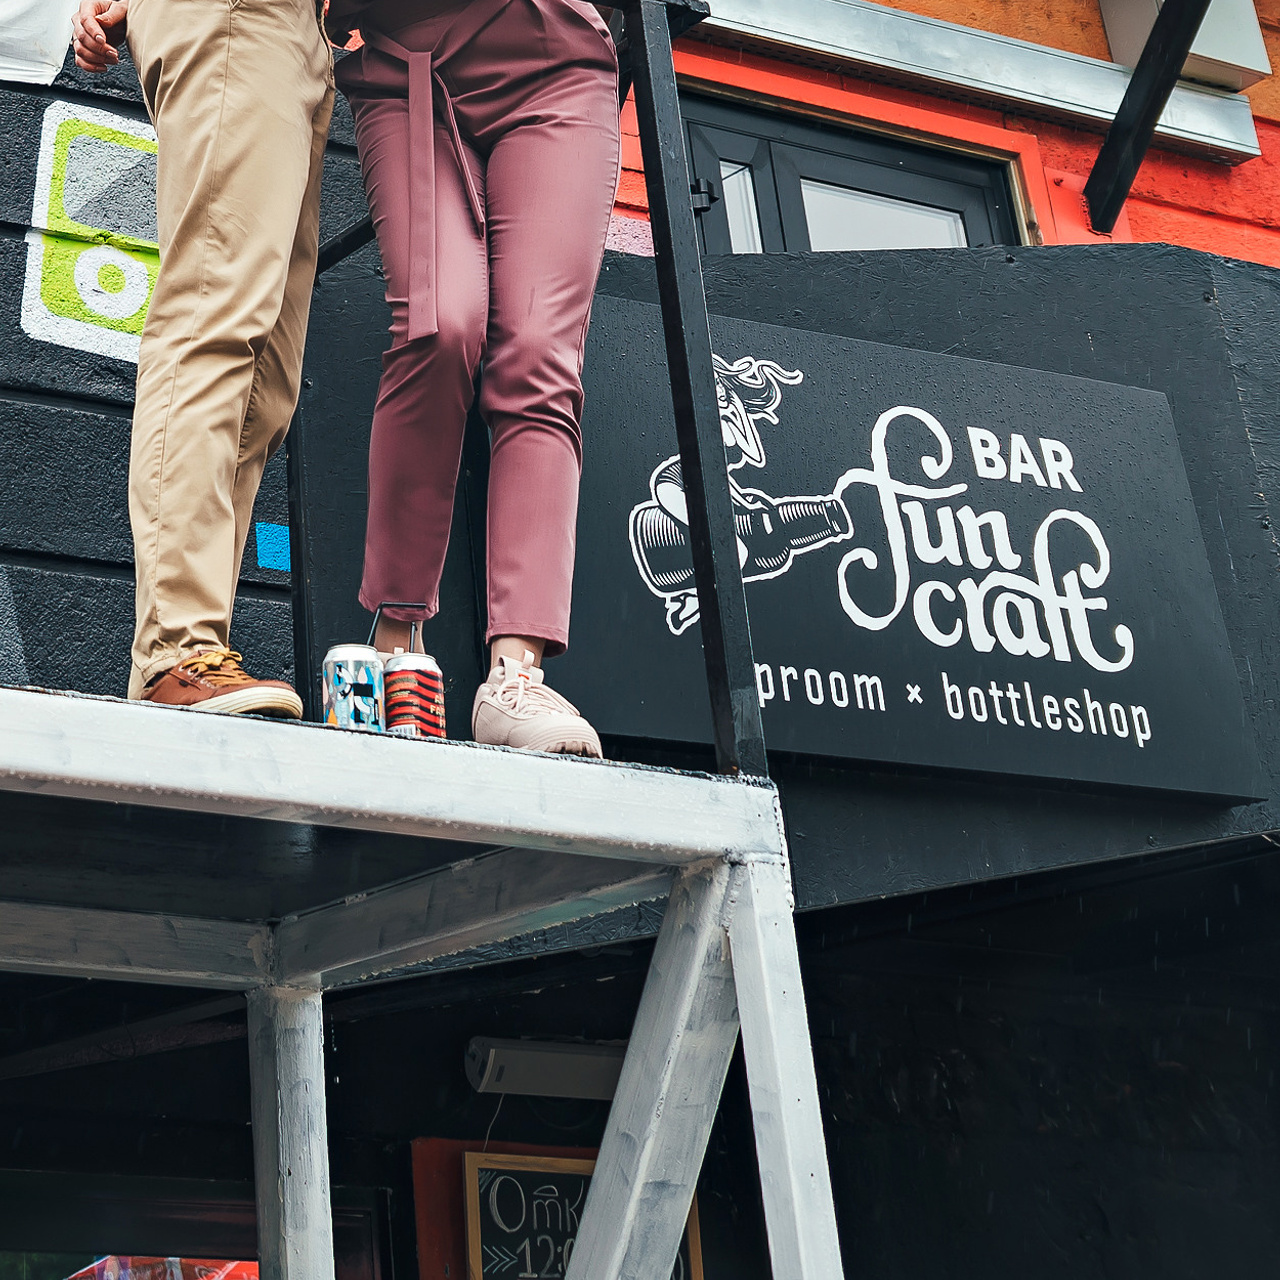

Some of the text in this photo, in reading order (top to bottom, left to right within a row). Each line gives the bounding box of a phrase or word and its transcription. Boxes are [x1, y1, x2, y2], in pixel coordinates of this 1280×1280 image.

[967, 426, 1082, 493] BAR
[913, 509, 1135, 672] craft
[754, 661, 887, 712] proom
[942, 673, 1152, 748] bottleshop
